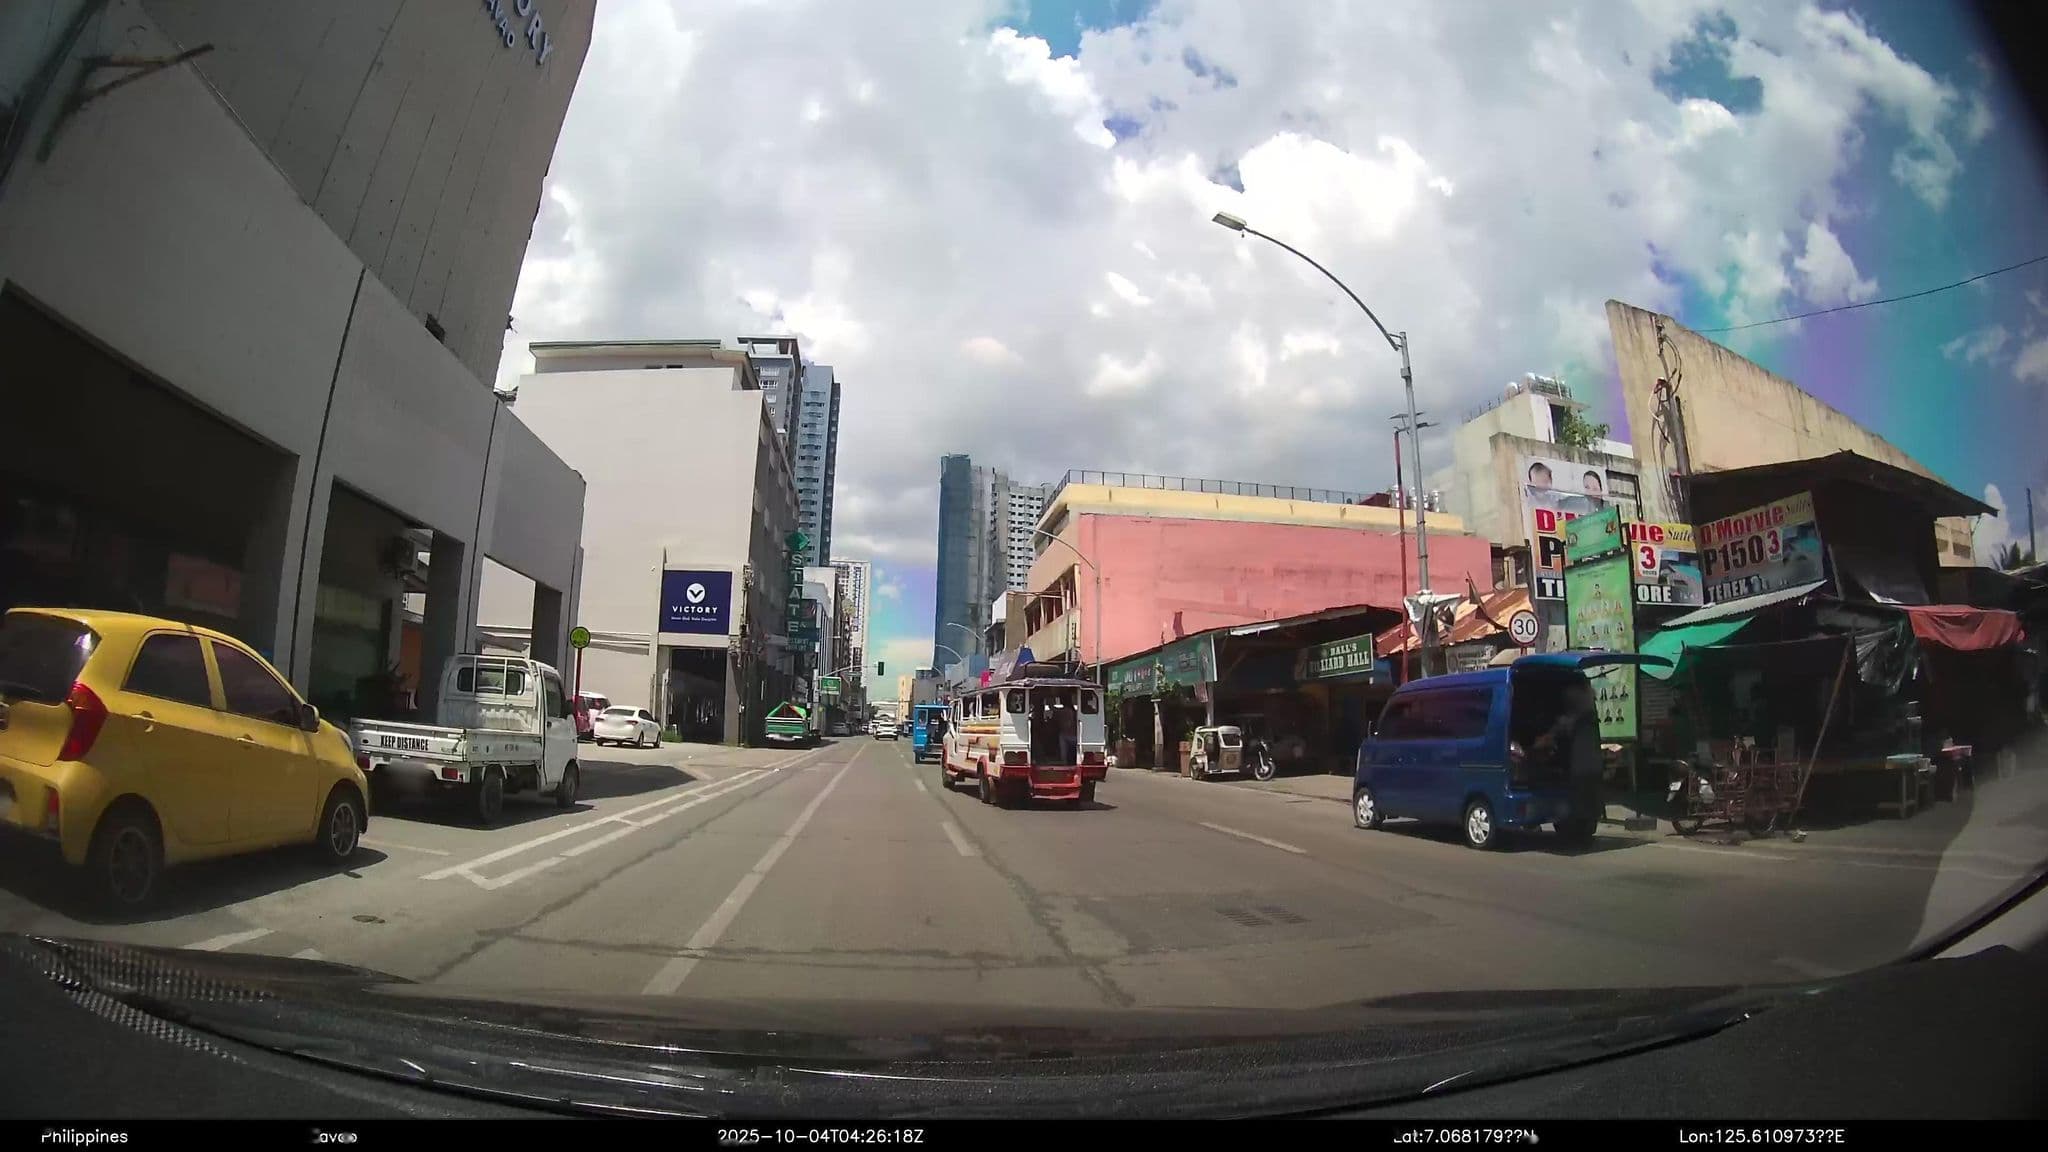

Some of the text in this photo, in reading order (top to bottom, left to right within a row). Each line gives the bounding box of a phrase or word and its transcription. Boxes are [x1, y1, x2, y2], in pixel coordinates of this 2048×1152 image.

[1701, 505, 1784, 545] D'Morvie
[1640, 545, 1656, 570] 3
[672, 605, 718, 614] VICTORY
[1513, 618, 1536, 636] 30
[1347, 651, 1370, 667] HALL
[380, 734, 429, 751] KEEP DISTANCE
